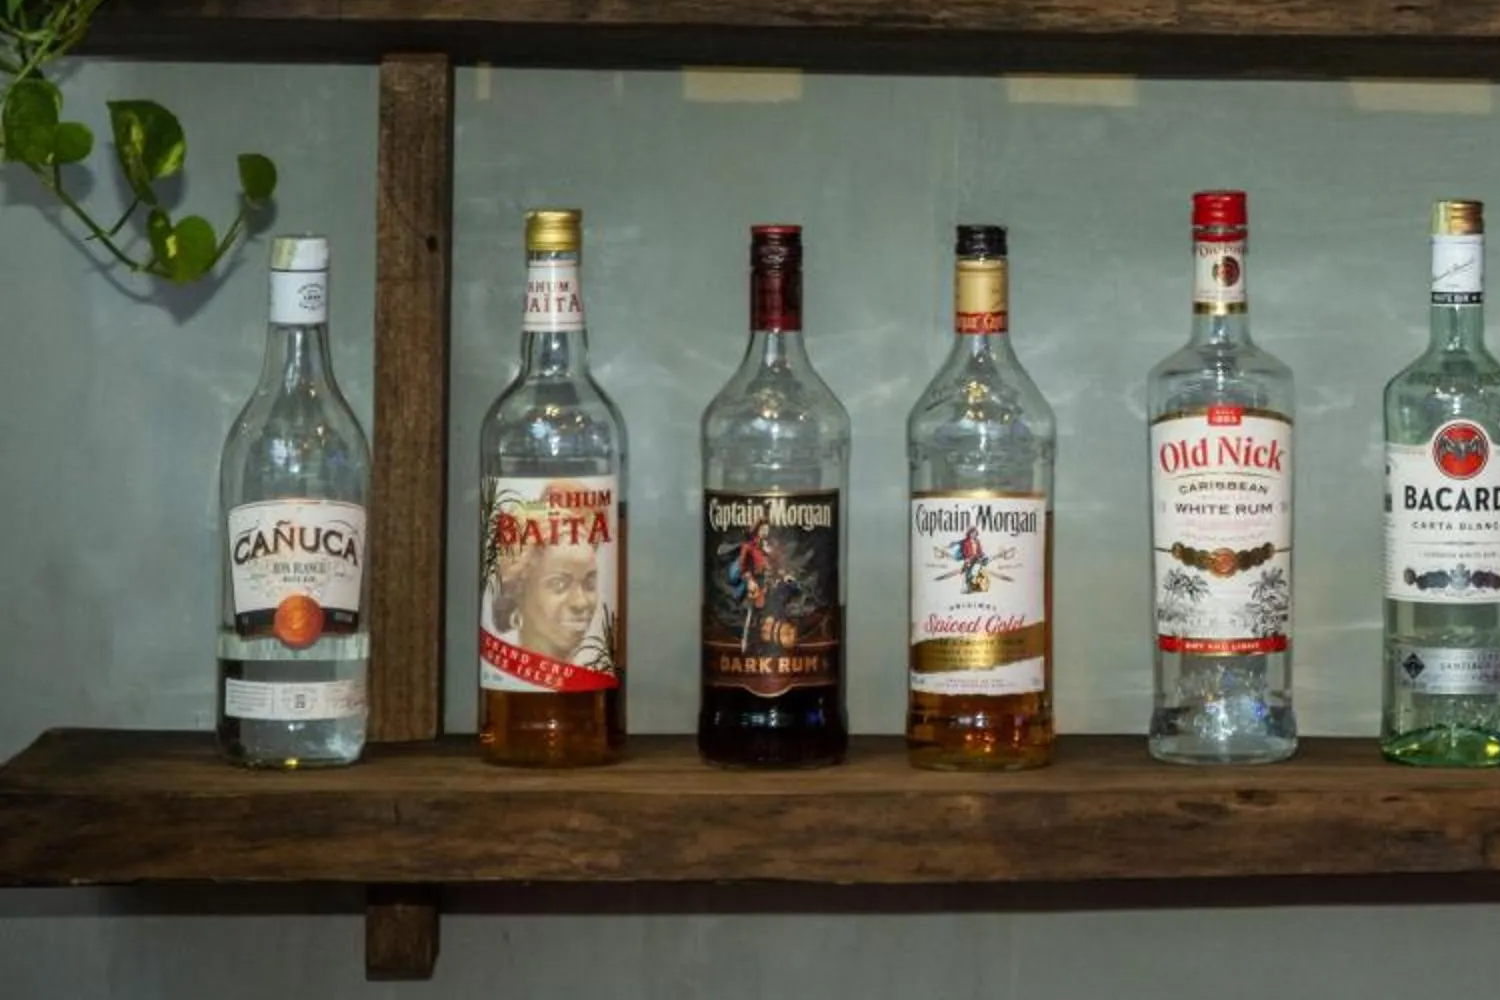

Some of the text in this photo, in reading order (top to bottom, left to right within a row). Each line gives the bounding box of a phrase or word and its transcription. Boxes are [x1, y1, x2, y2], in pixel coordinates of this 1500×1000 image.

[1160, 436, 1285, 473] Old Nick
[548, 489, 612, 509] RHUM
[1178, 480, 1270, 496] CARIBBEAN
[709, 498, 831, 531] Captain Morgan
[1175, 503, 1274, 516] WHITE RUM
[915, 503, 1037, 539] Captain Morgan
[1411, 520, 1453, 531] CARTA
[233, 520, 359, 568] CAÑUCA
[923, 612, 981, 636] Spiced
[720, 655, 819, 673] DARK RUM
